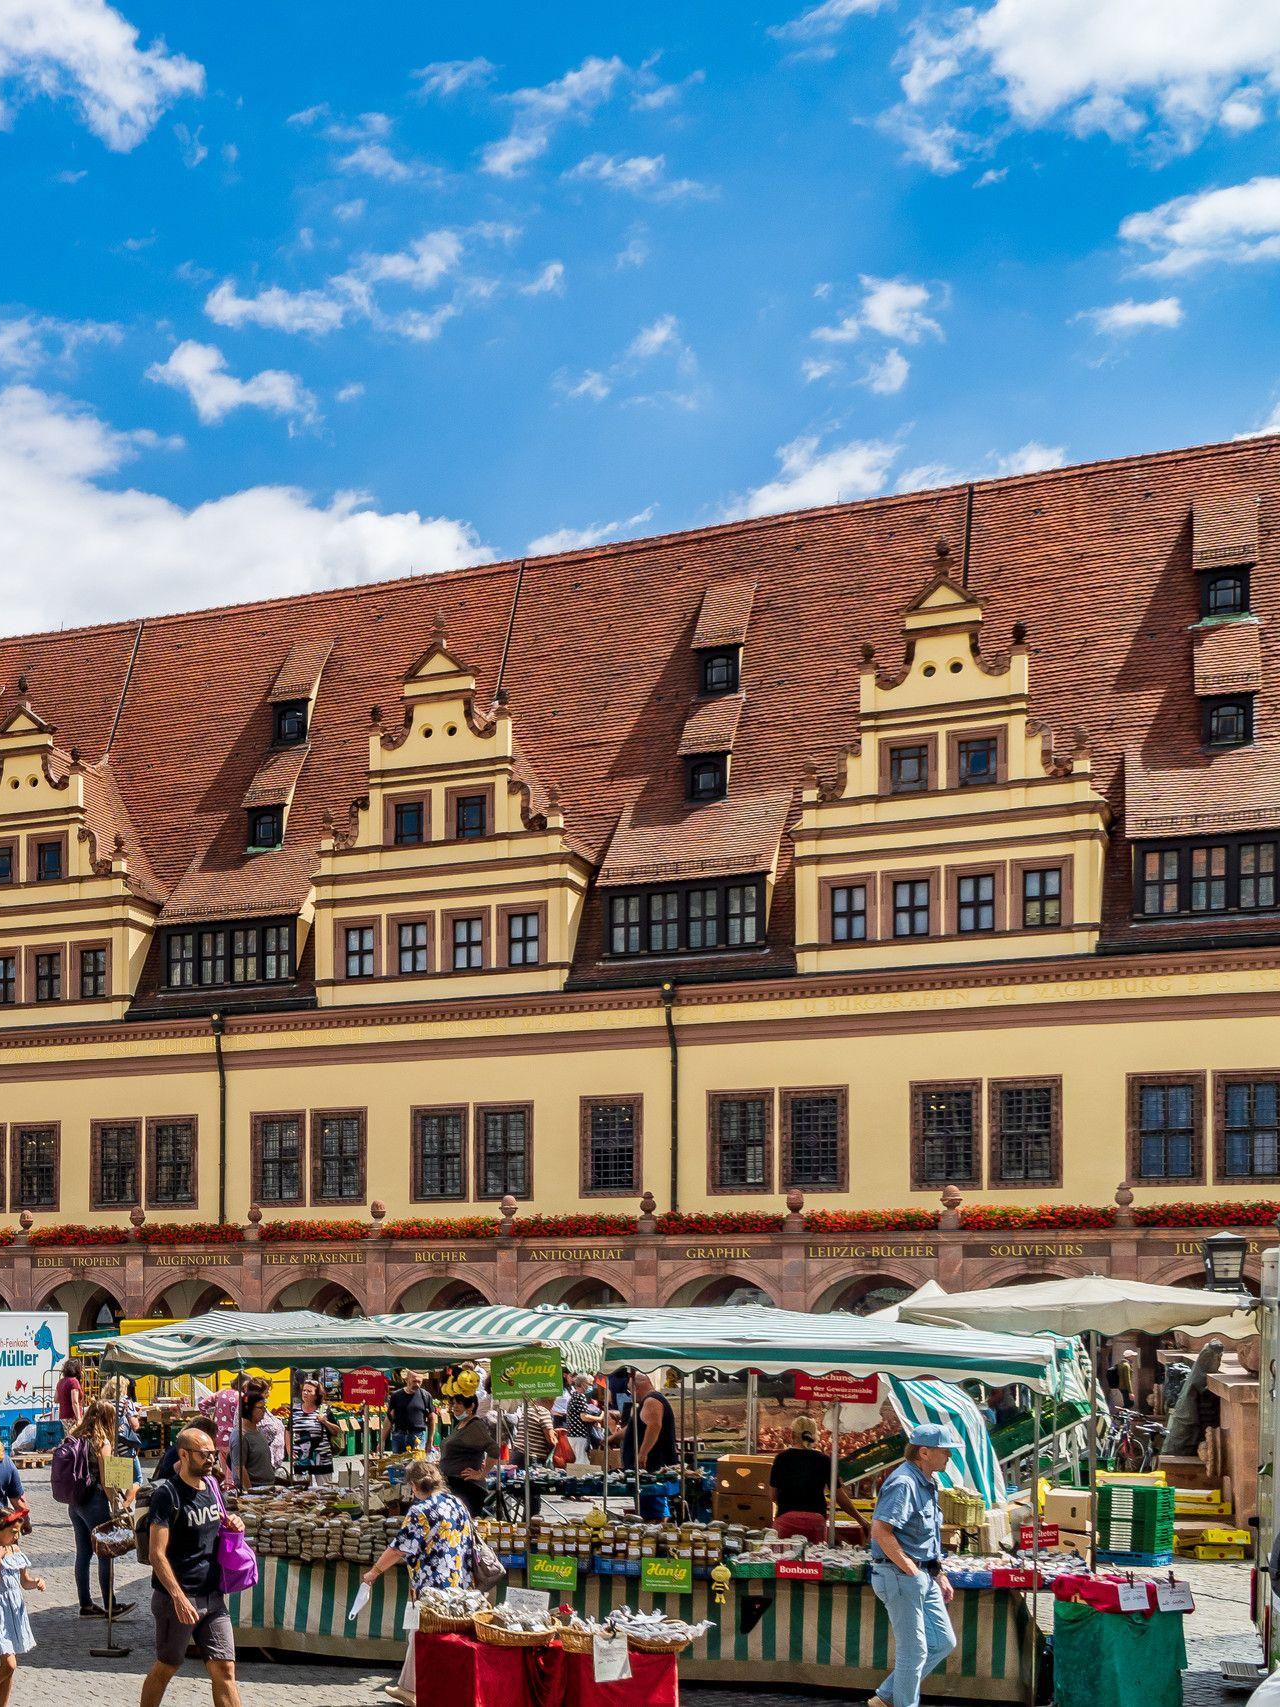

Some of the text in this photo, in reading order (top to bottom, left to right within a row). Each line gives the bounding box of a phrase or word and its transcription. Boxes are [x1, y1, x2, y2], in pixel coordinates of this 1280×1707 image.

[529, 1248, 624, 1261] ANTIQUARIAT
[686, 1246, 752, 1260] GRAPHIK
[990, 1243, 1084, 1257] SOUVENIRS
[37, 1256, 120, 1267] EDLE TROPFEN
[156, 1255, 231, 1265] AUGENOPTIK
[265, 1251, 363, 1265] TEE & PRÄSENTE
[515, 1360, 556, 1377] Honig
[187, 1504, 220, 1527] NAS
[1022, 1530, 1057, 1539] Frütetee
[534, 1559, 573, 1577] Honig
[646, 1562, 687, 1580] Honig
[779, 1564, 820, 1575] Bonbons
[1009, 1574, 1027, 1583] Tee
